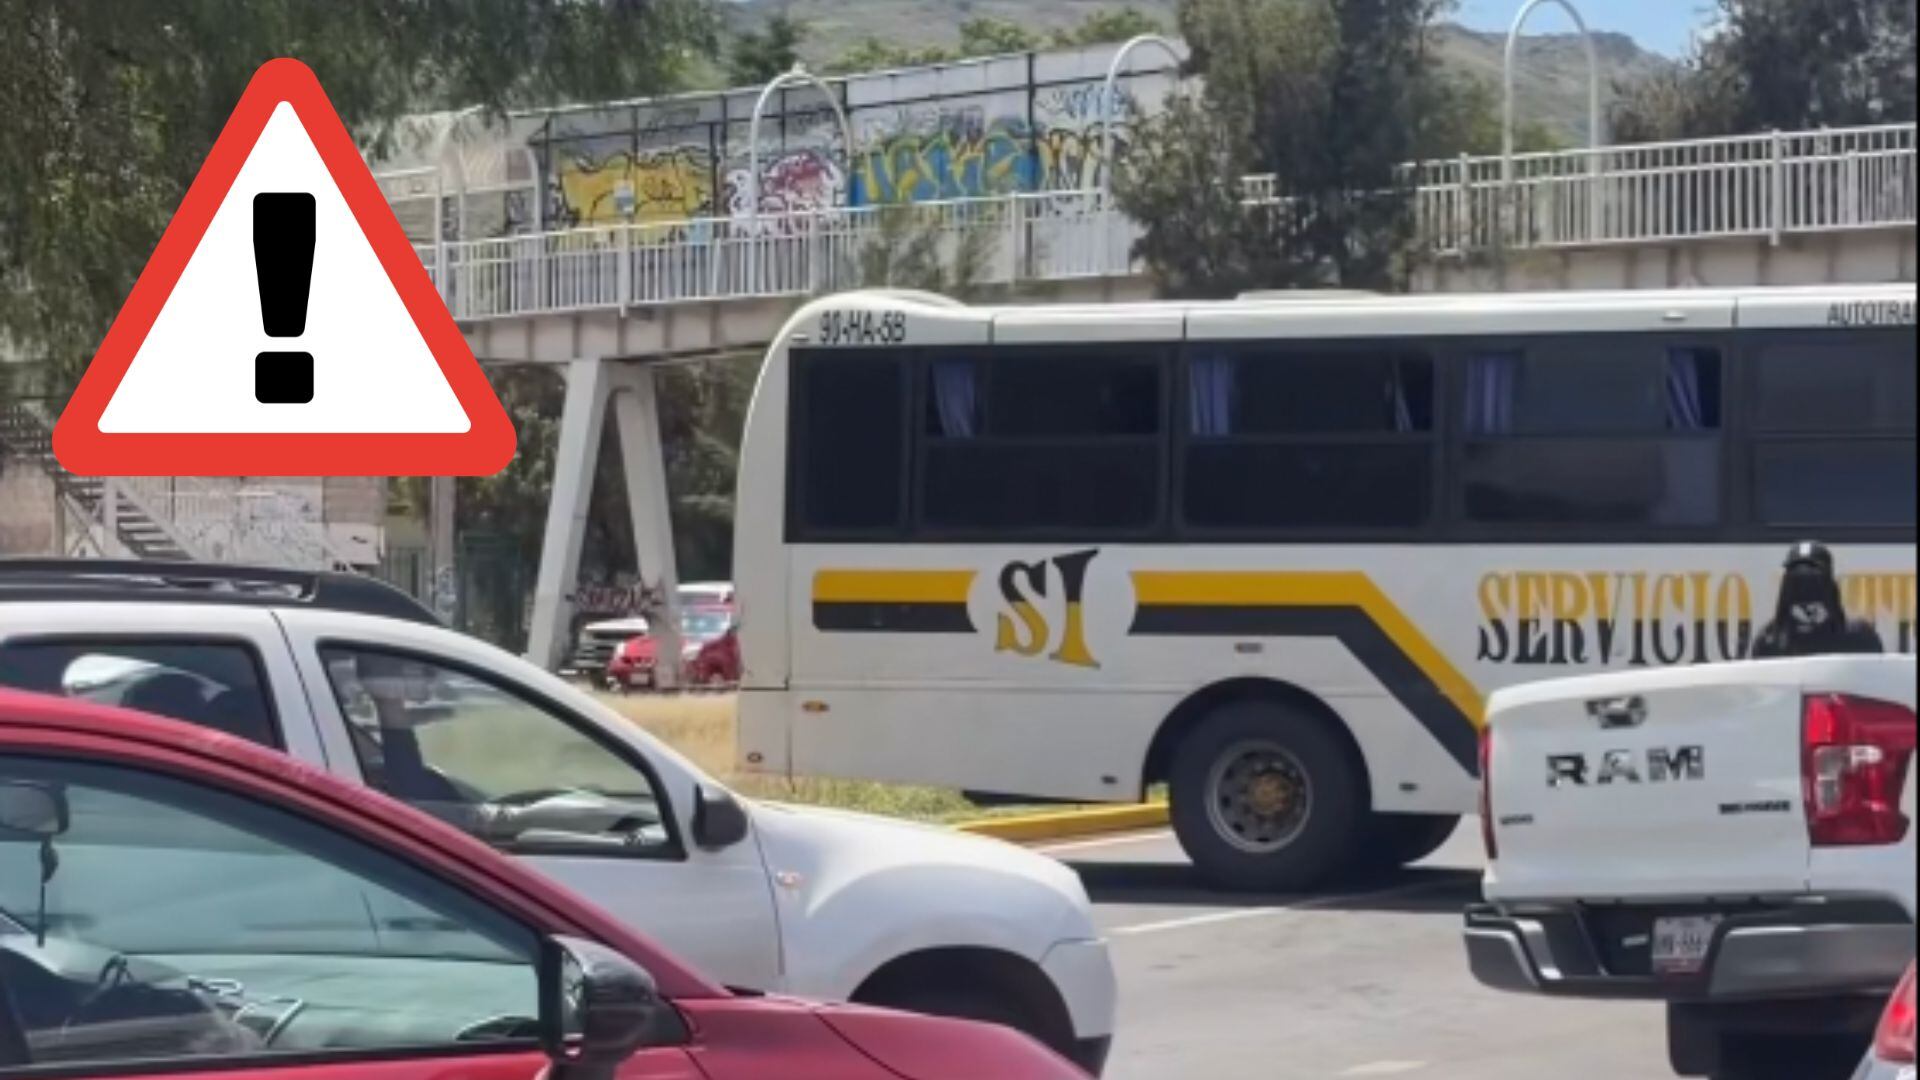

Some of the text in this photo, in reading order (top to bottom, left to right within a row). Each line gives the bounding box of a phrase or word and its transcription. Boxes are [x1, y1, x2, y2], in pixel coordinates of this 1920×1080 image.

[994, 548, 1102, 668] SI
[1477, 571, 1752, 664] SERVICIO
[1546, 744, 1704, 788] RAM
